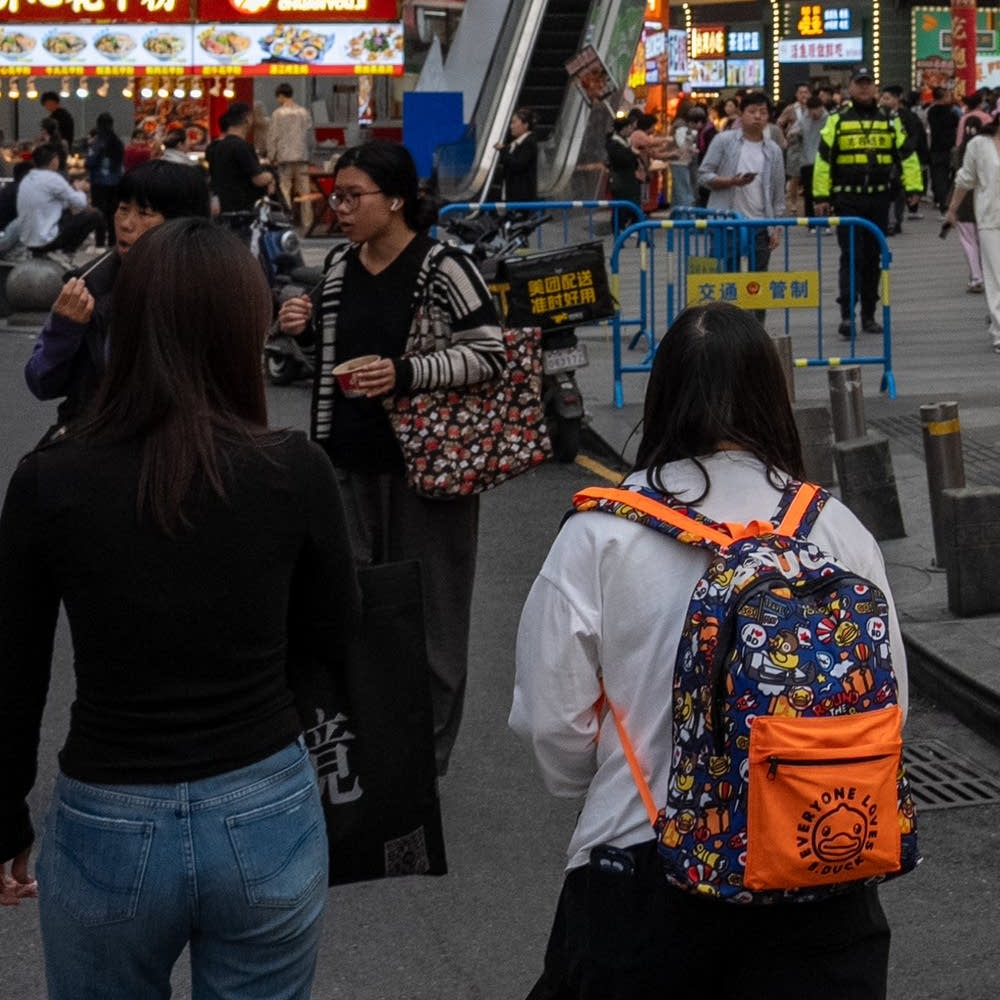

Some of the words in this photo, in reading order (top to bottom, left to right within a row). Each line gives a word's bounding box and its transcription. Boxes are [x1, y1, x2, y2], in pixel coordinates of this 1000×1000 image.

[528, 269, 593, 297] 美团配送
[698, 281, 738, 301] 交通
[768, 279, 809, 300] 管制
[530, 287, 597, 313] 准时好用
[796, 786, 857, 859] EVERYONE
[861, 794, 878, 851] LOVES
[807, 856, 864, 875] B.DUCK
